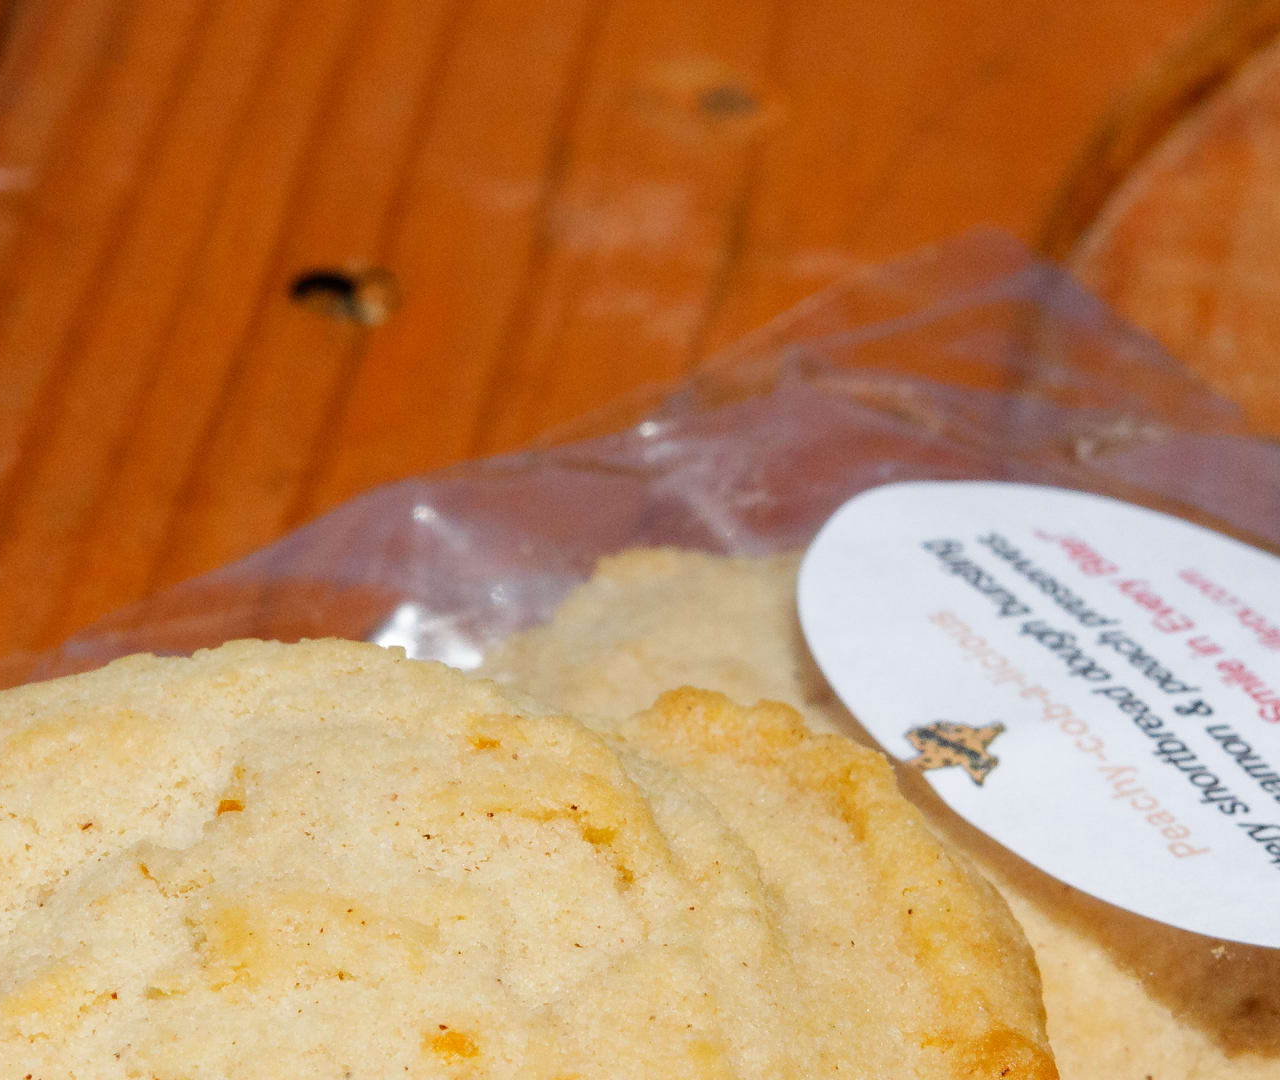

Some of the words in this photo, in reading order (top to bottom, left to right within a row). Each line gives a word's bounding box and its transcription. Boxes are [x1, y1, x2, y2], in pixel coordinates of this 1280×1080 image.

[920, 537, 1034, 619] bursting
[1111, 578, 1197, 635] Every
[1017, 619, 1114, 684] dough
[1094, 629, 1203, 696] peach
[1185, 634, 1225, 660] in
[1172, 697, 1217, 719] &
[1090, 684, 1252, 817] shortbread
